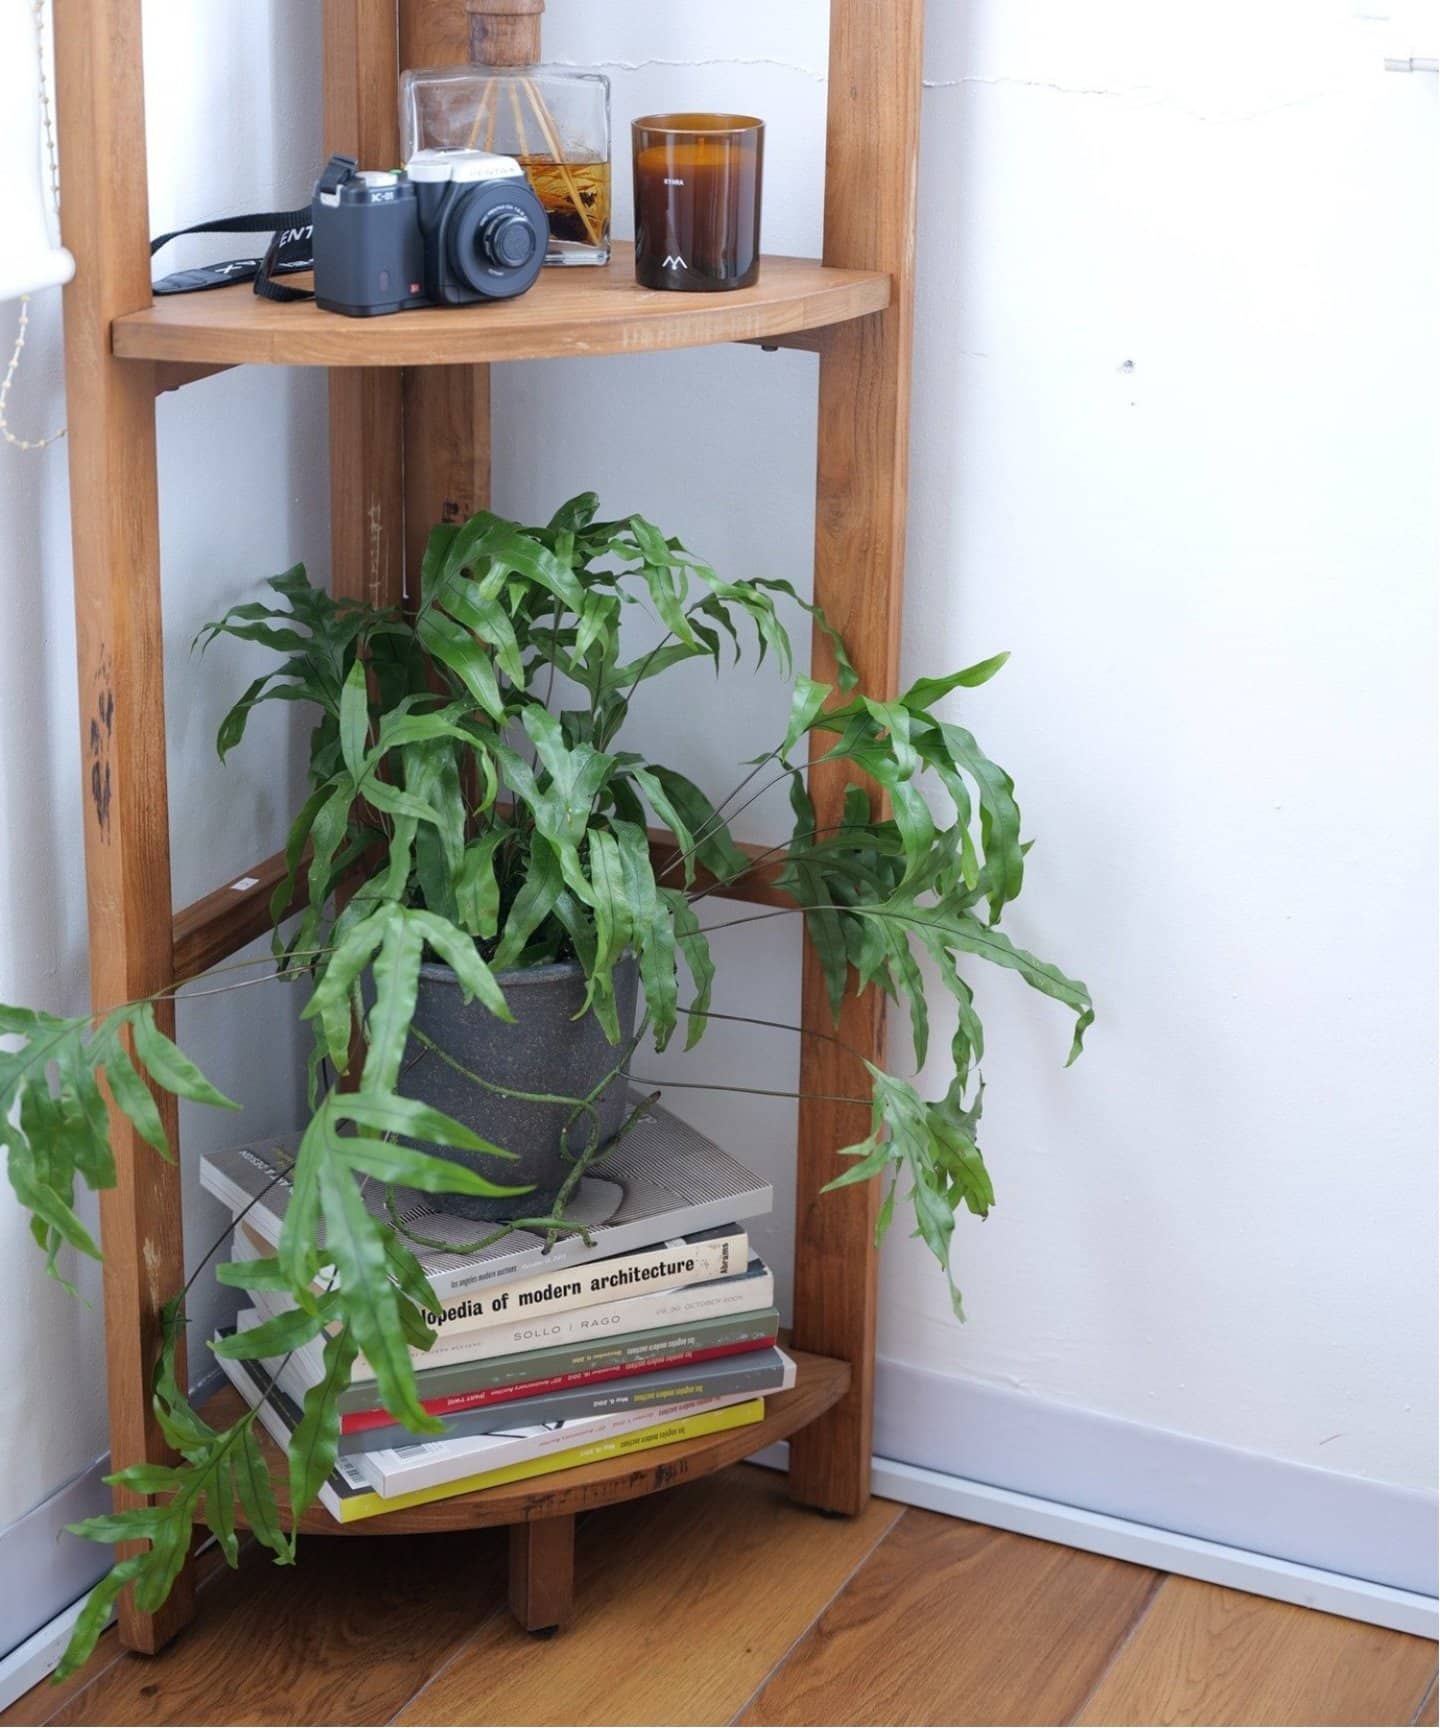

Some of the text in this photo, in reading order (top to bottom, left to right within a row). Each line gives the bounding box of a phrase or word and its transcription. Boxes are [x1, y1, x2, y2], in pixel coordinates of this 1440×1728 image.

[720, 1242, 729, 1274] Abrams
[421, 1258, 695, 1327] lopedia of modern architecture
[513, 1326, 561, 1342] SOLLO
[580, 1314, 622, 1330] RAGO
